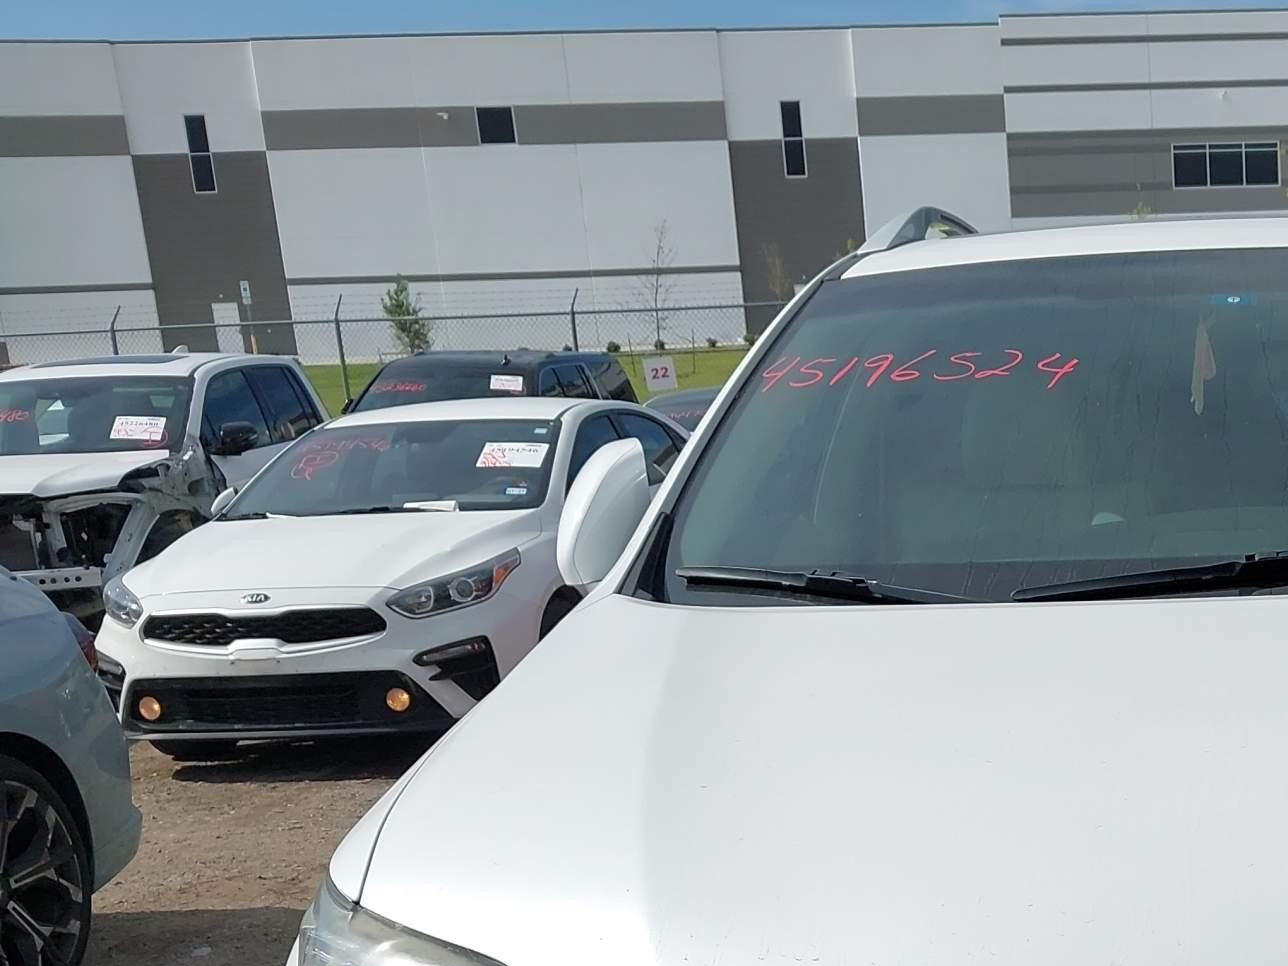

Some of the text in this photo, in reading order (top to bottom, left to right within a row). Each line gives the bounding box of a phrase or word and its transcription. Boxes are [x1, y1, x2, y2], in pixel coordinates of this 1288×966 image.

[650, 366, 670, 380] 22
[761, 350, 1080, 392] 45196524
[241, 593, 270, 604] KIA
